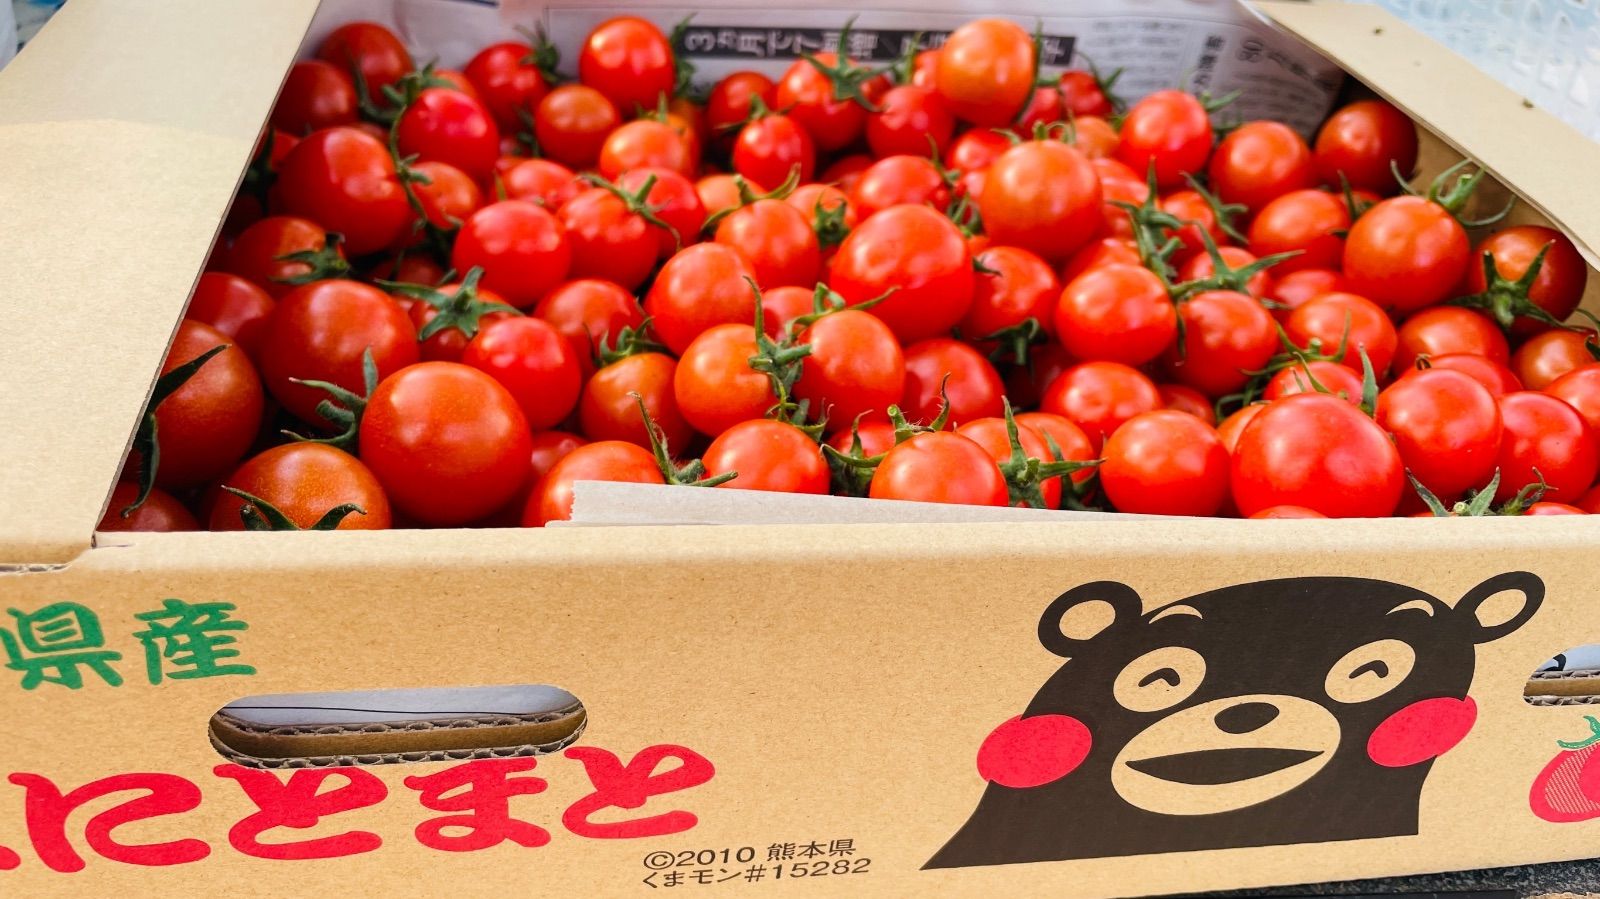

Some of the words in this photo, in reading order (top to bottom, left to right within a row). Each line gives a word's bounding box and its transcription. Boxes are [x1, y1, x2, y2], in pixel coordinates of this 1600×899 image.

[0, 599, 257, 690] 県産
[0, 744, 716, 874] にとまと
[766, 838, 857, 862] 熊本県
